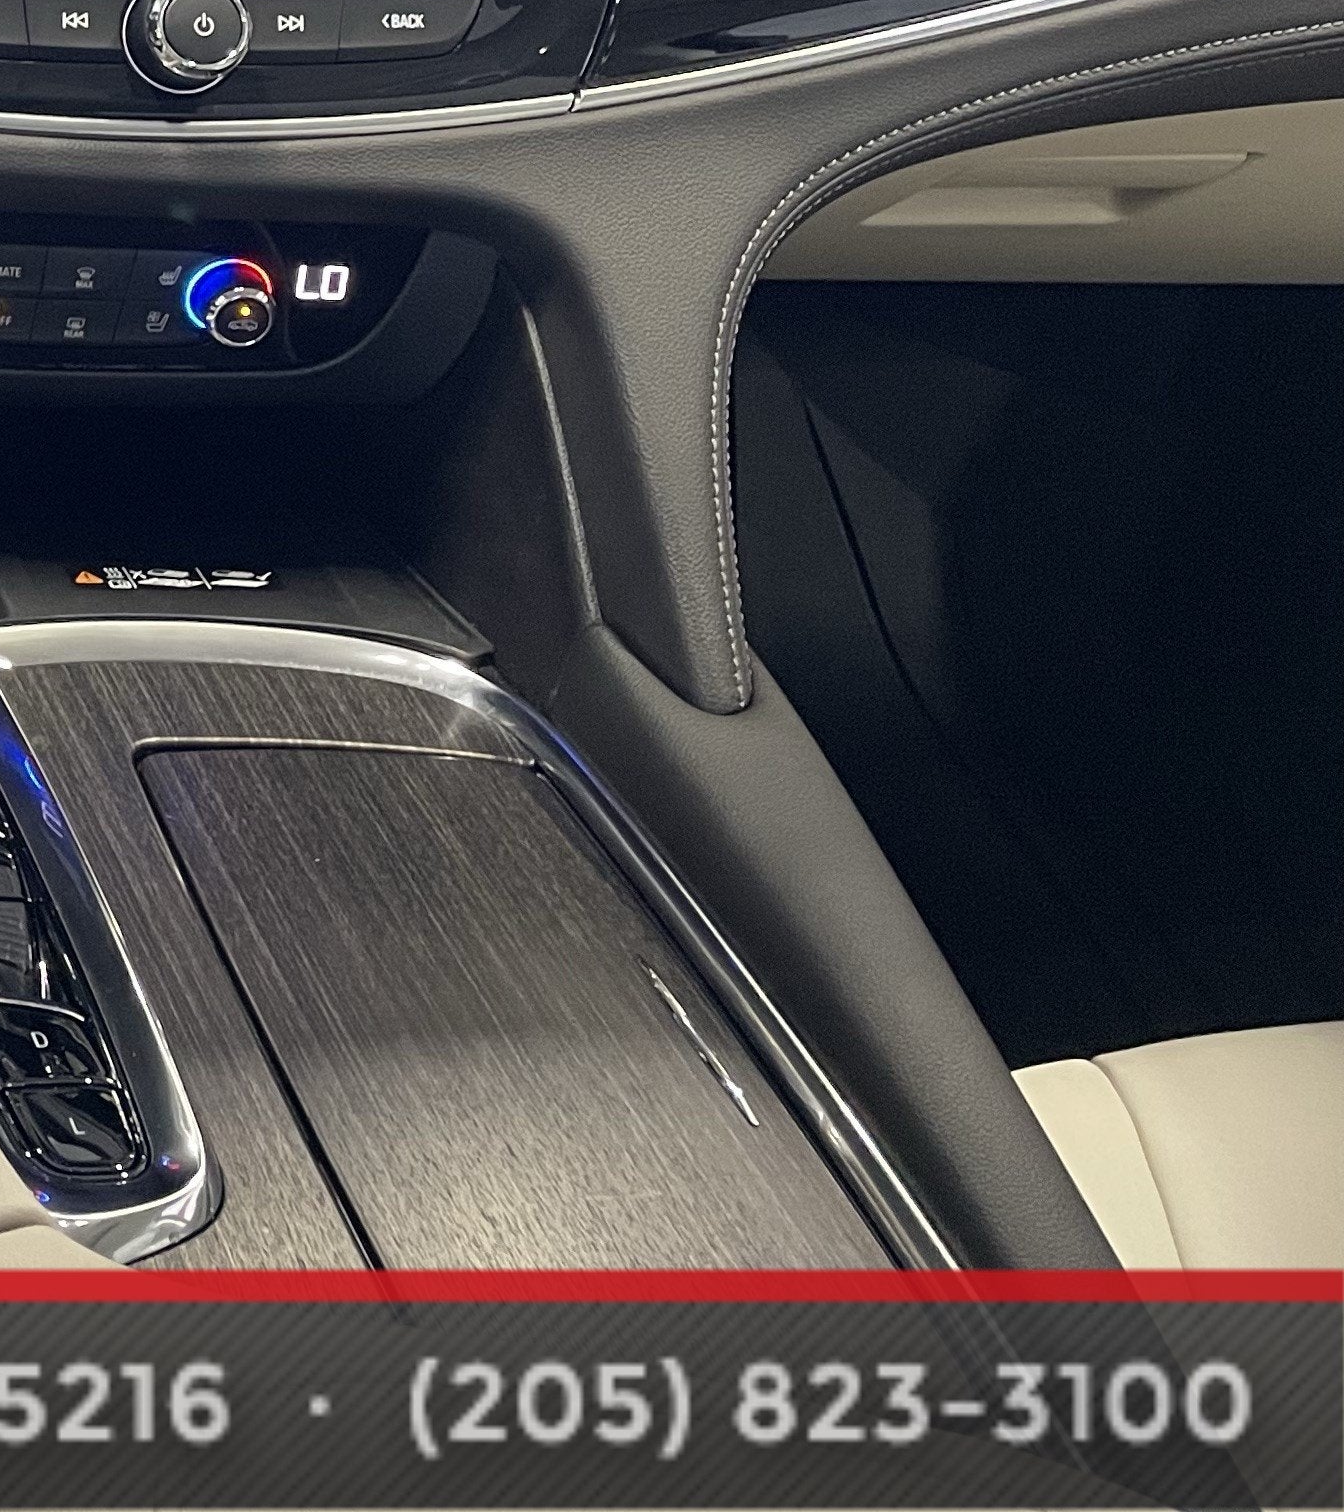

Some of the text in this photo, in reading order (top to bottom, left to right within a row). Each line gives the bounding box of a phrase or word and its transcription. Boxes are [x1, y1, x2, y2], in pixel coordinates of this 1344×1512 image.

[391, 13, 424, 30] BACK
[295, 264, 349, 300] LO
[31, 1031, 49, 1049] D
[69, 1117, 86, 1135] L
